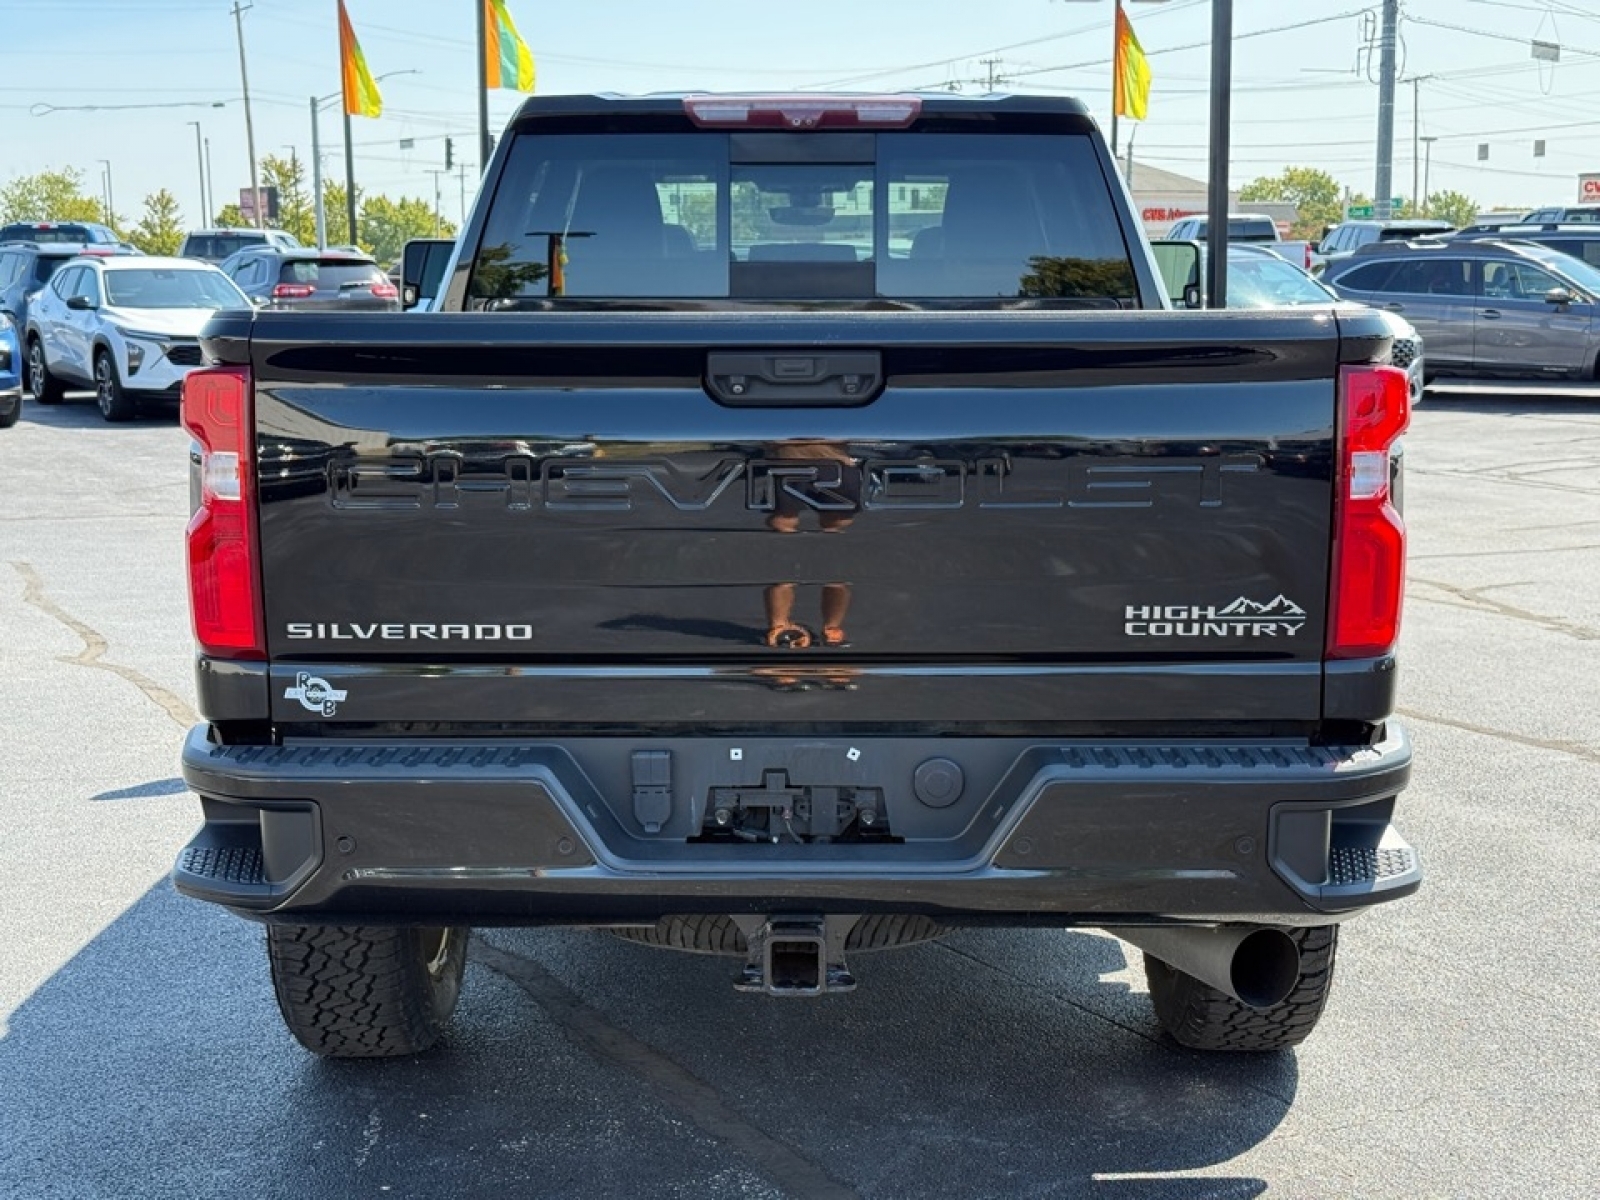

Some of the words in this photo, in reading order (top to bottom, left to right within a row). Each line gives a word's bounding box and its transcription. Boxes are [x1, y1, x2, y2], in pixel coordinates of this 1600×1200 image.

[1143, 208, 1166, 221] CVS
[327, 456, 1262, 511] CHEVROLET
[1125, 605, 1216, 619] HIGH
[286, 623, 533, 640] SILVERADO
[1124, 622, 1306, 636] COUNTRY
